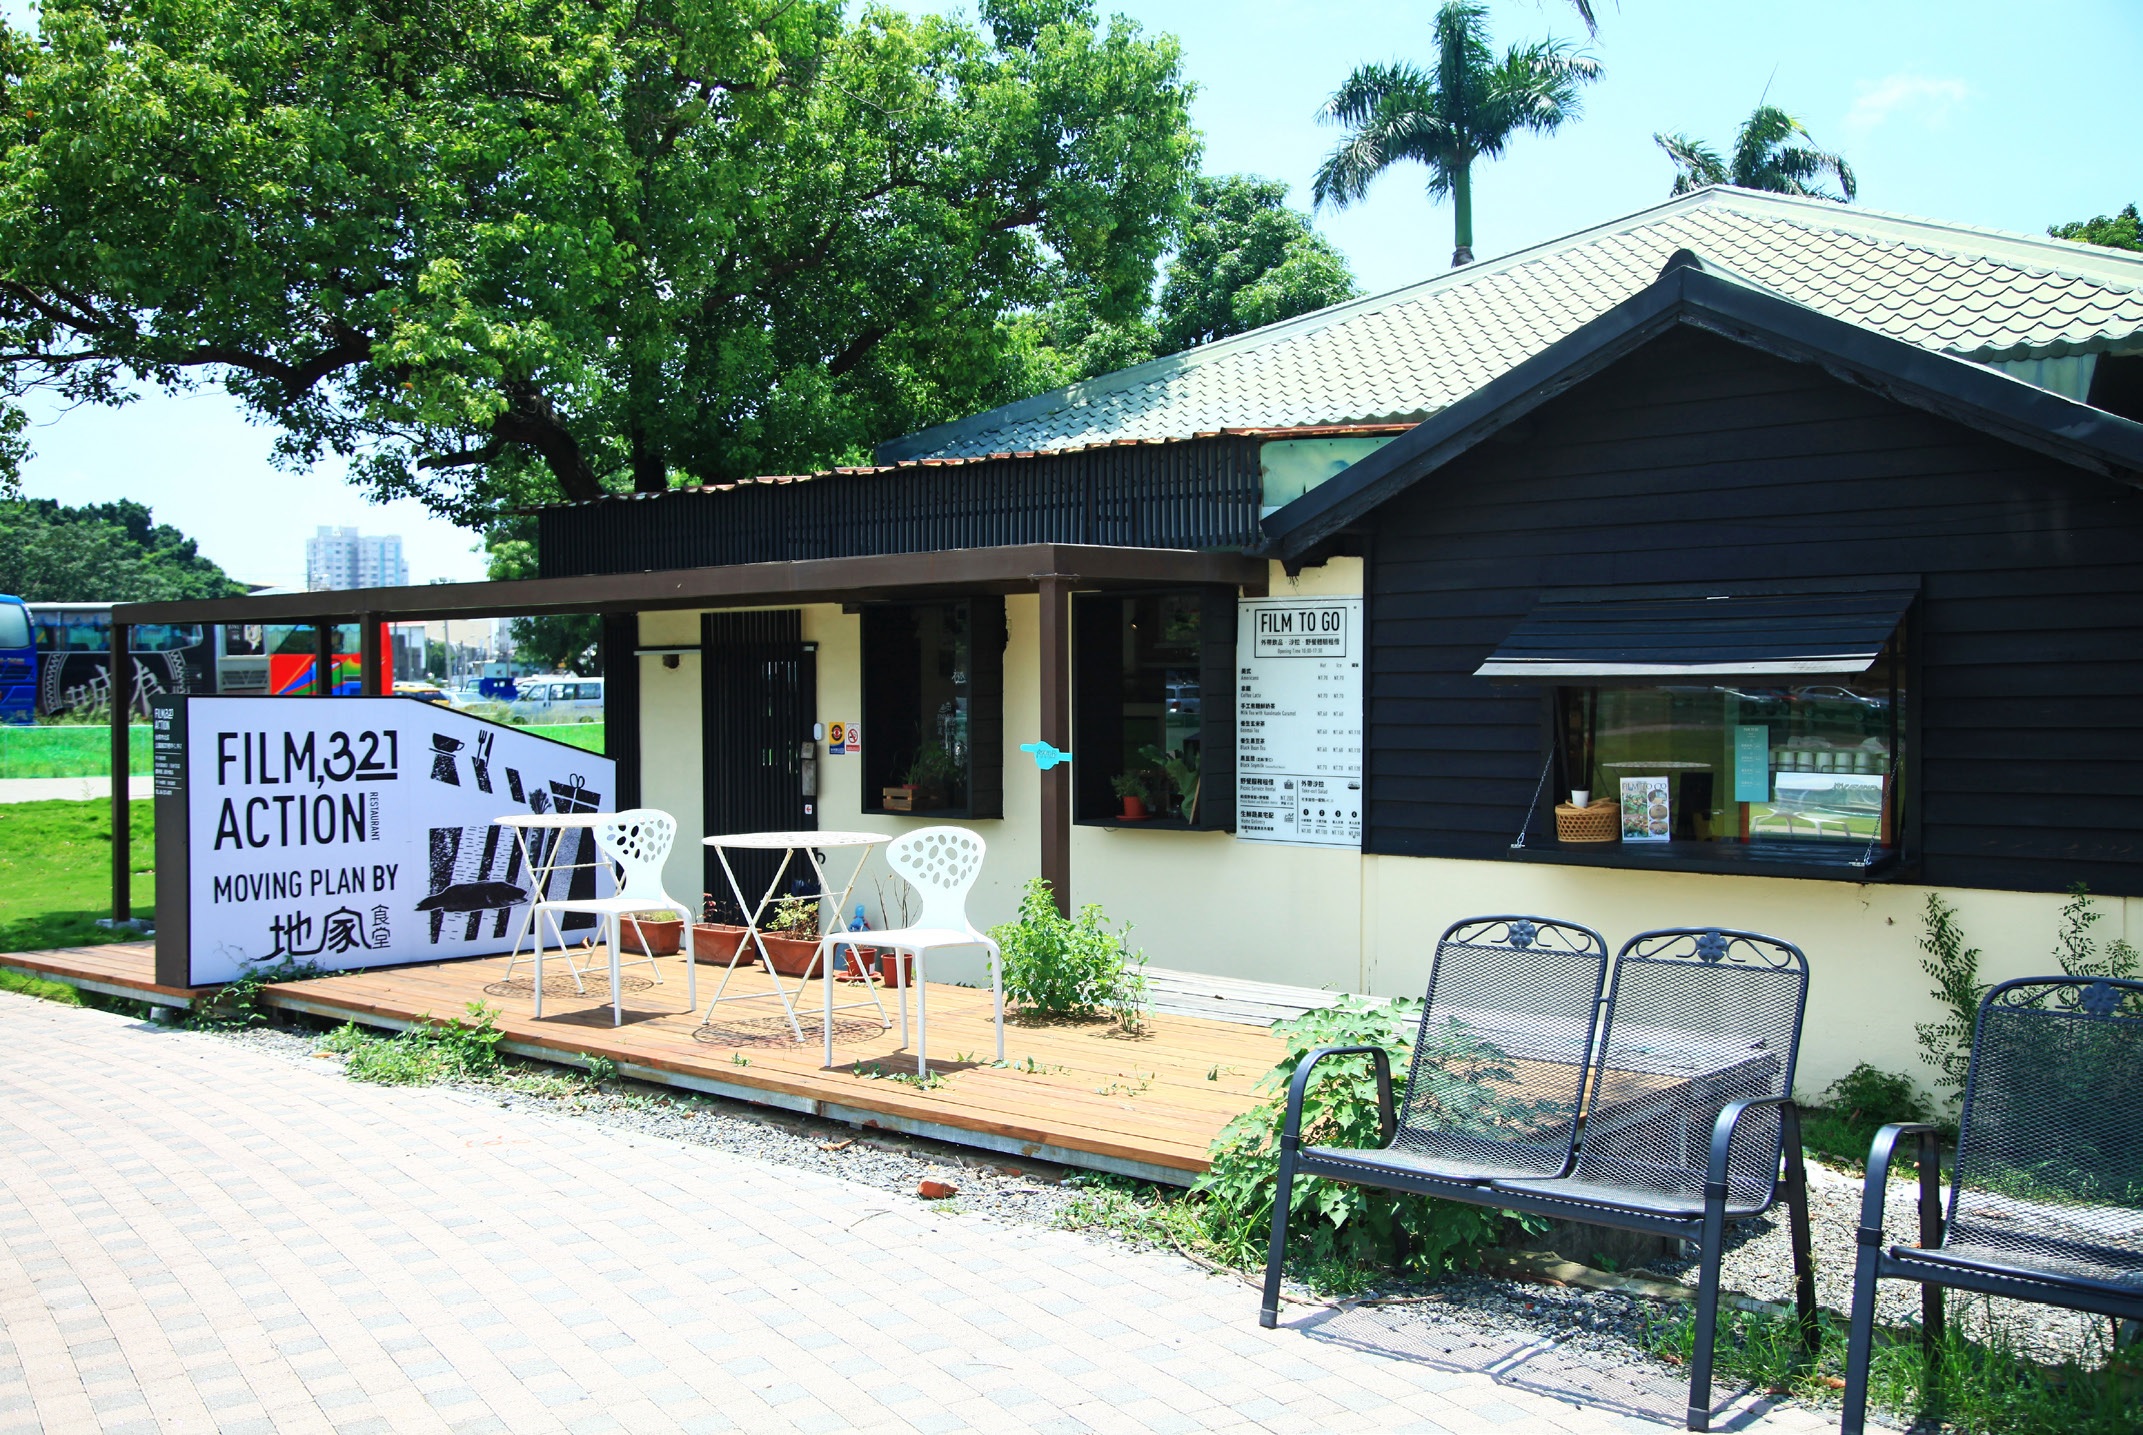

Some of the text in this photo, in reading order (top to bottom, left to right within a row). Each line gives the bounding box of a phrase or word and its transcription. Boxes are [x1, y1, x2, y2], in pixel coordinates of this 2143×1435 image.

[1261, 611, 1340, 632] FILM TO GO
[214, 792, 366, 850] ACTION
[369, 791, 380, 841] RESTAURANT
[214, 863, 399, 904] MOVING PLAN BY
[371, 904, 391, 950] 食堂
